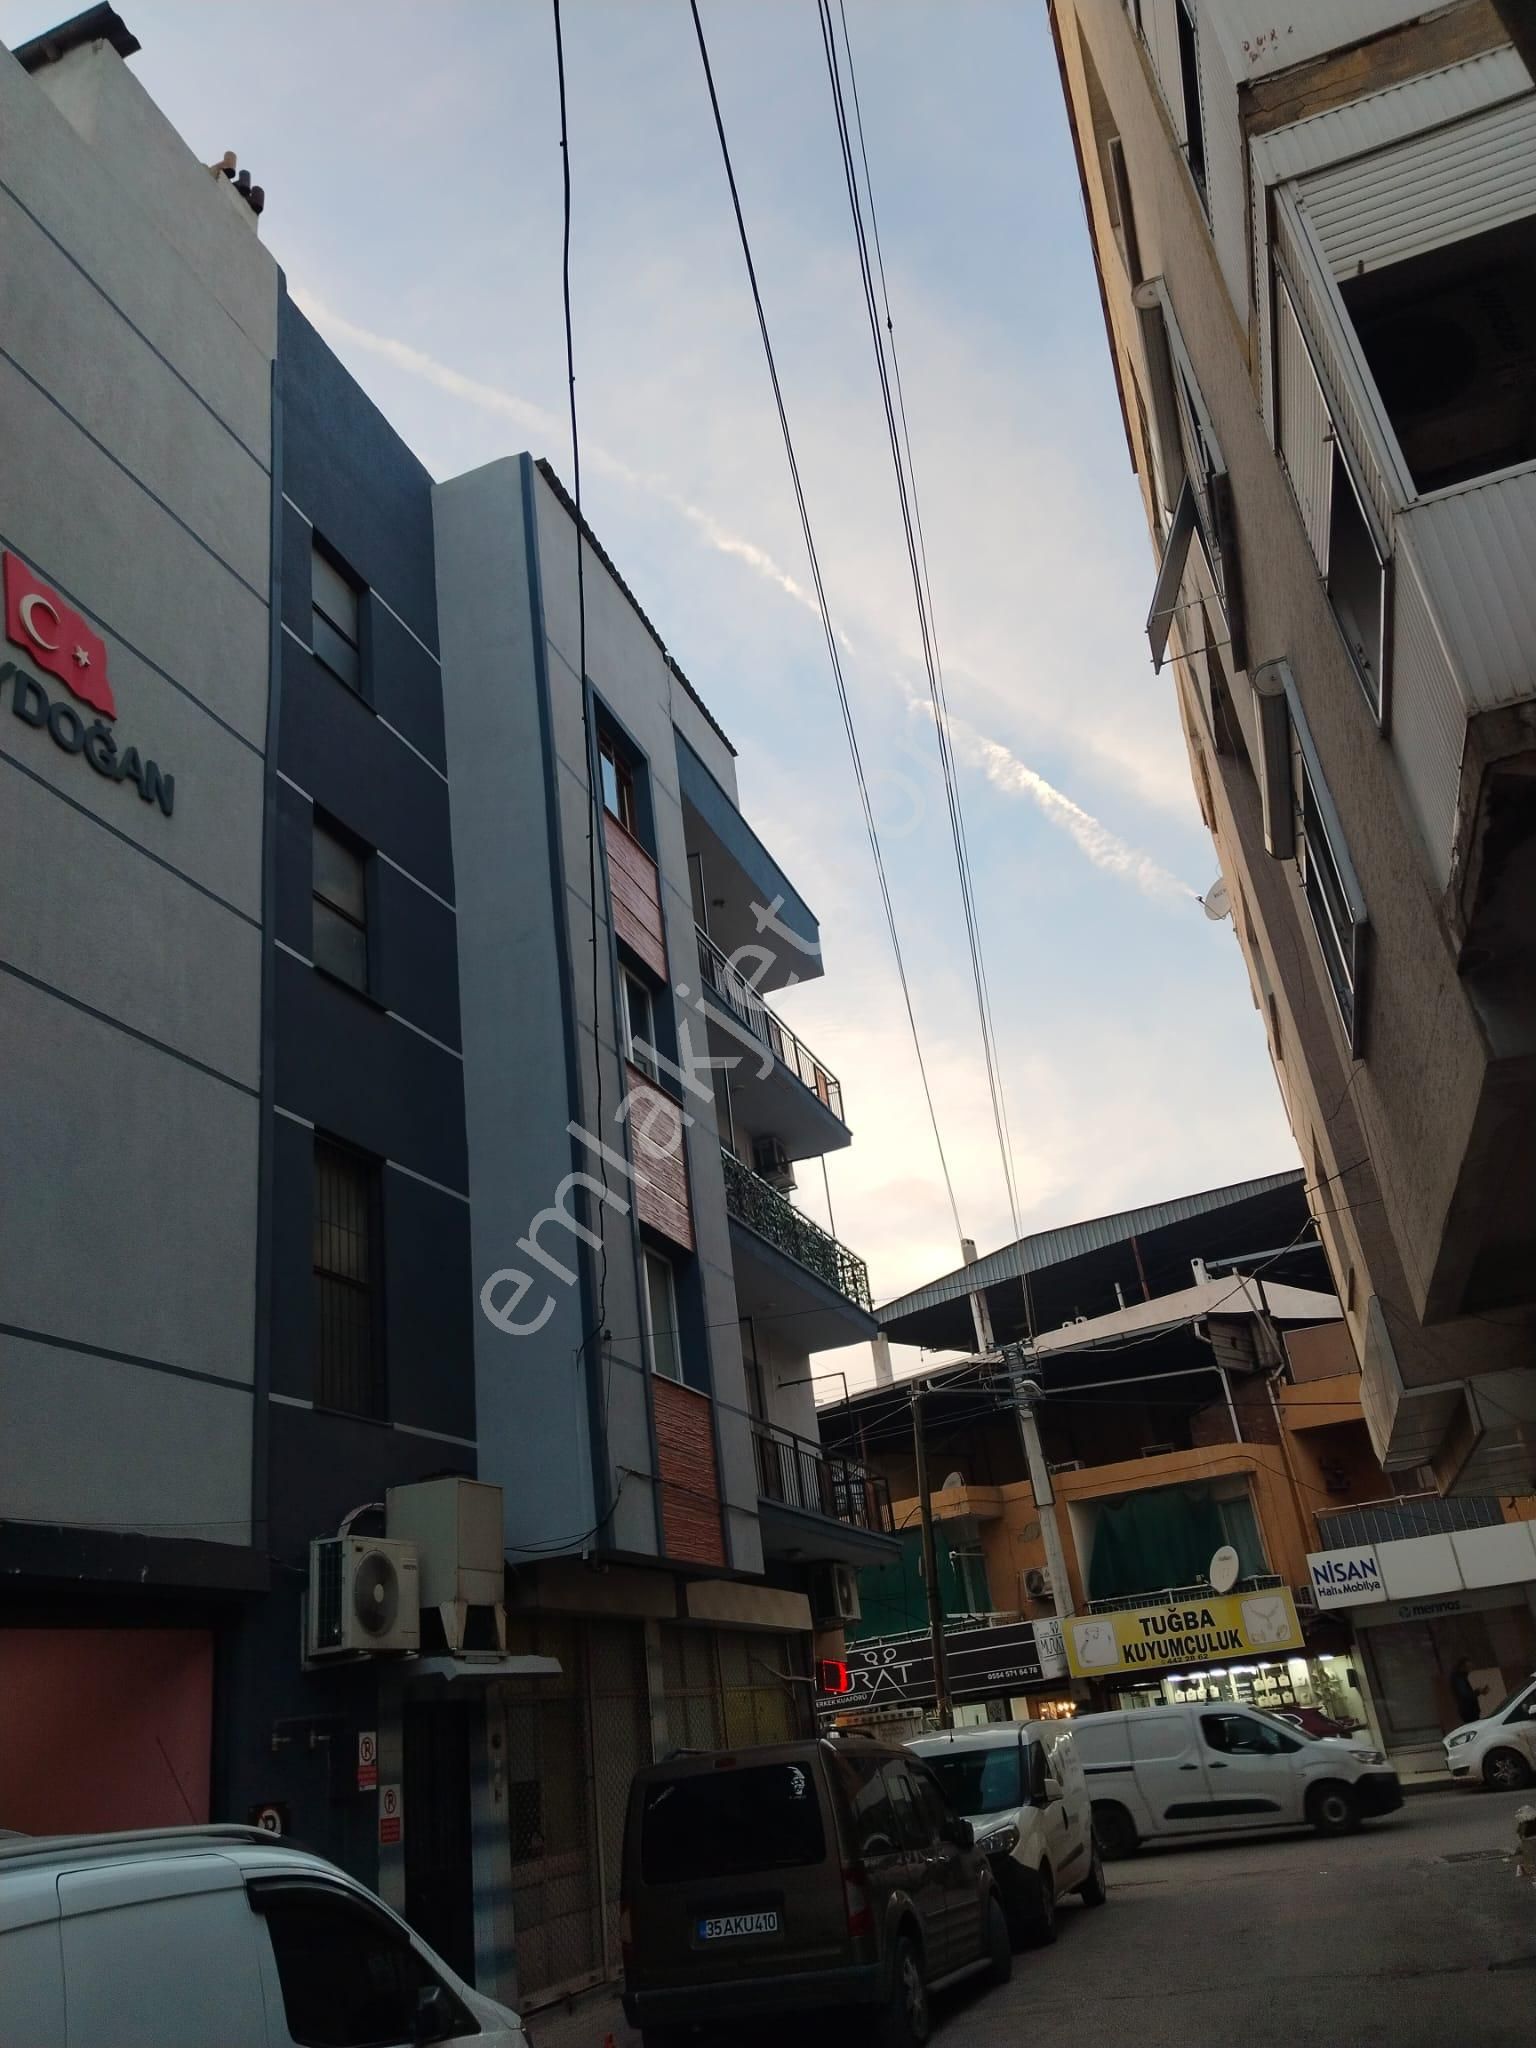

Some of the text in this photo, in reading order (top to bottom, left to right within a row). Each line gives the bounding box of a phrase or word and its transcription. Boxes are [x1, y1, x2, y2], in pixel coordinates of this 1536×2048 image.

[1312, 1558, 1378, 1585] NİSAN
[1139, 1608, 1216, 1637] TUĞBA
[1122, 1629, 1244, 1664] KUYUMCULUK
[815, 1699, 836, 1709] ERKEK
